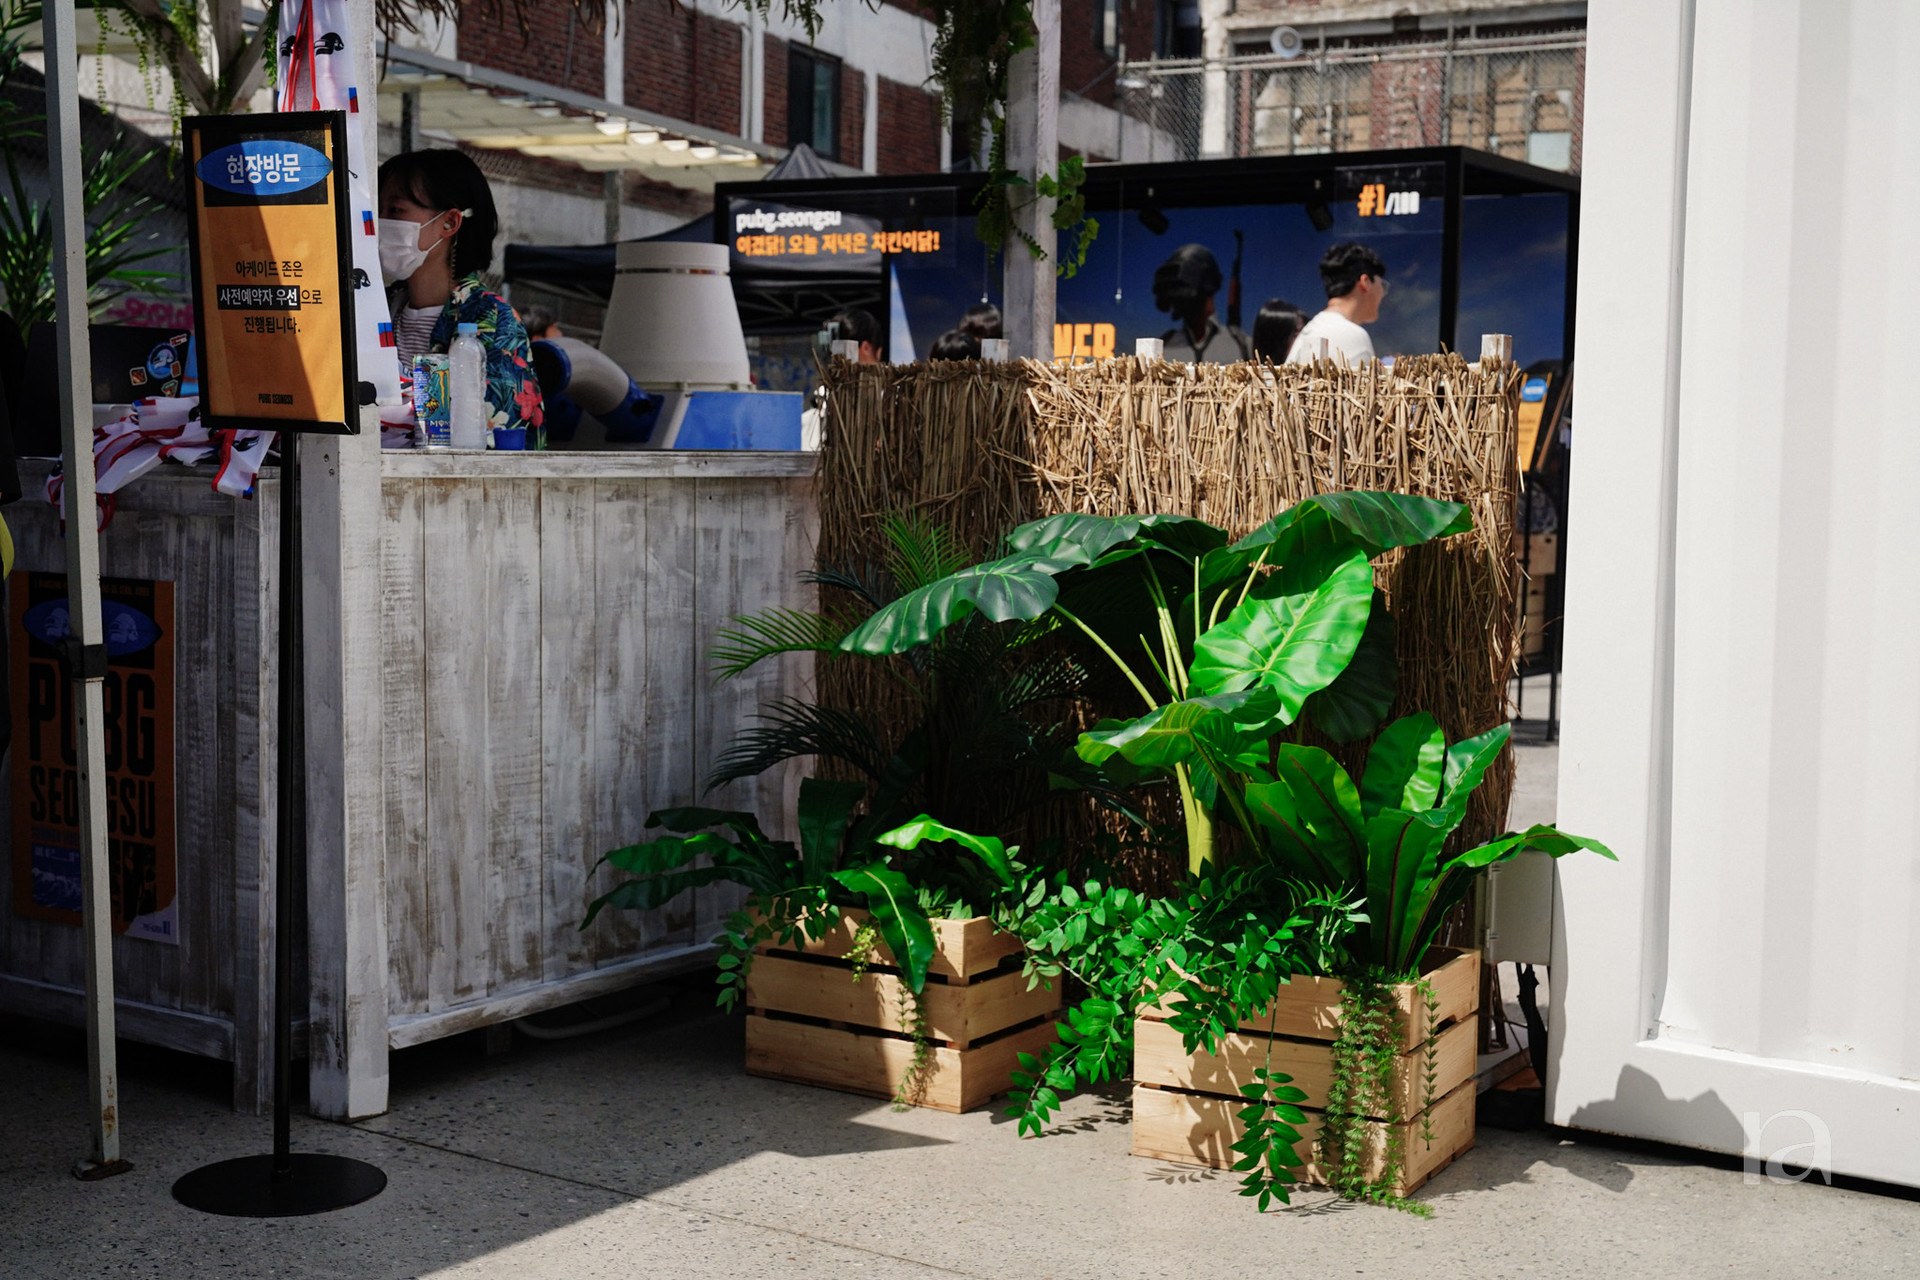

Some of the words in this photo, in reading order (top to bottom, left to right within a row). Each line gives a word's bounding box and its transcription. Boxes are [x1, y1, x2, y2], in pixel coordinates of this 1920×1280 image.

[226, 153, 301, 184] 현장방문
[788, 233, 819, 255] 오늘
[821, 232, 868, 254] 저녁은
[235, 260, 279, 278] 아케이드
[281, 260, 304, 278] 존은
[220, 288, 273, 306] 사전예약자
[275, 288, 323, 306] 우선으로
[244, 316, 301, 335] 진행됩니다.
[30, 764, 156, 838] SEOGSU
